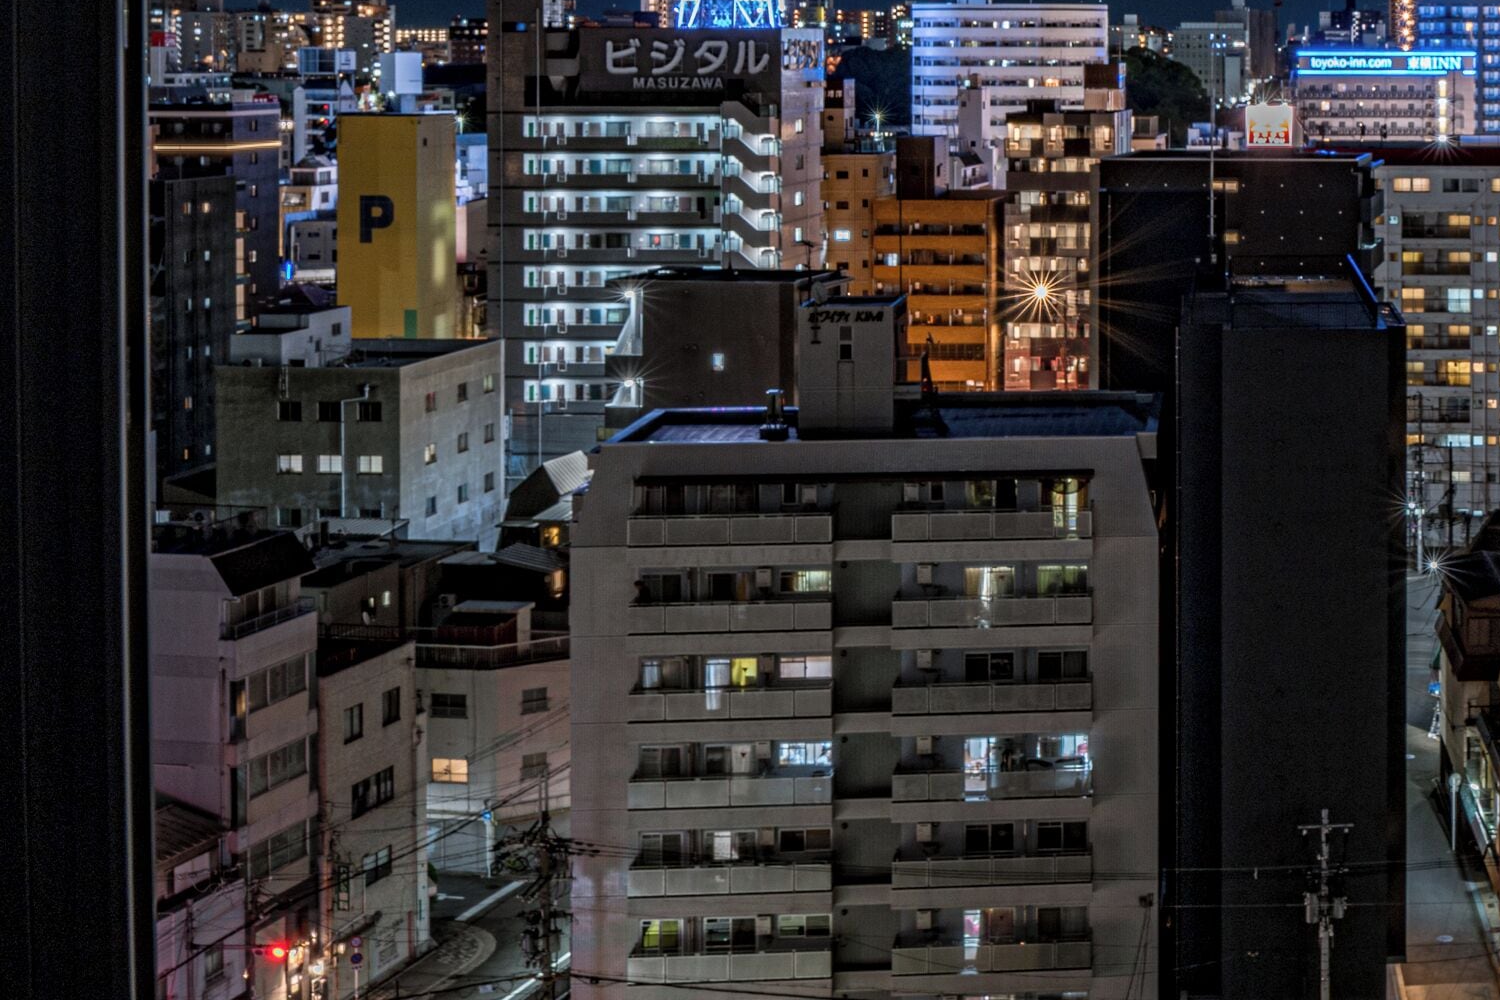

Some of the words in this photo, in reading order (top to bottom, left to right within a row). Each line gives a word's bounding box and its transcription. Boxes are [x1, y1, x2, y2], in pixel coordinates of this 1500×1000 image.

[606, 38, 770, 74] ビジタル
[1310, 56, 1392, 71] toyoko-inn.com
[633, 77, 724, 89] MASUZAWA
[359, 195, 394, 243] P
